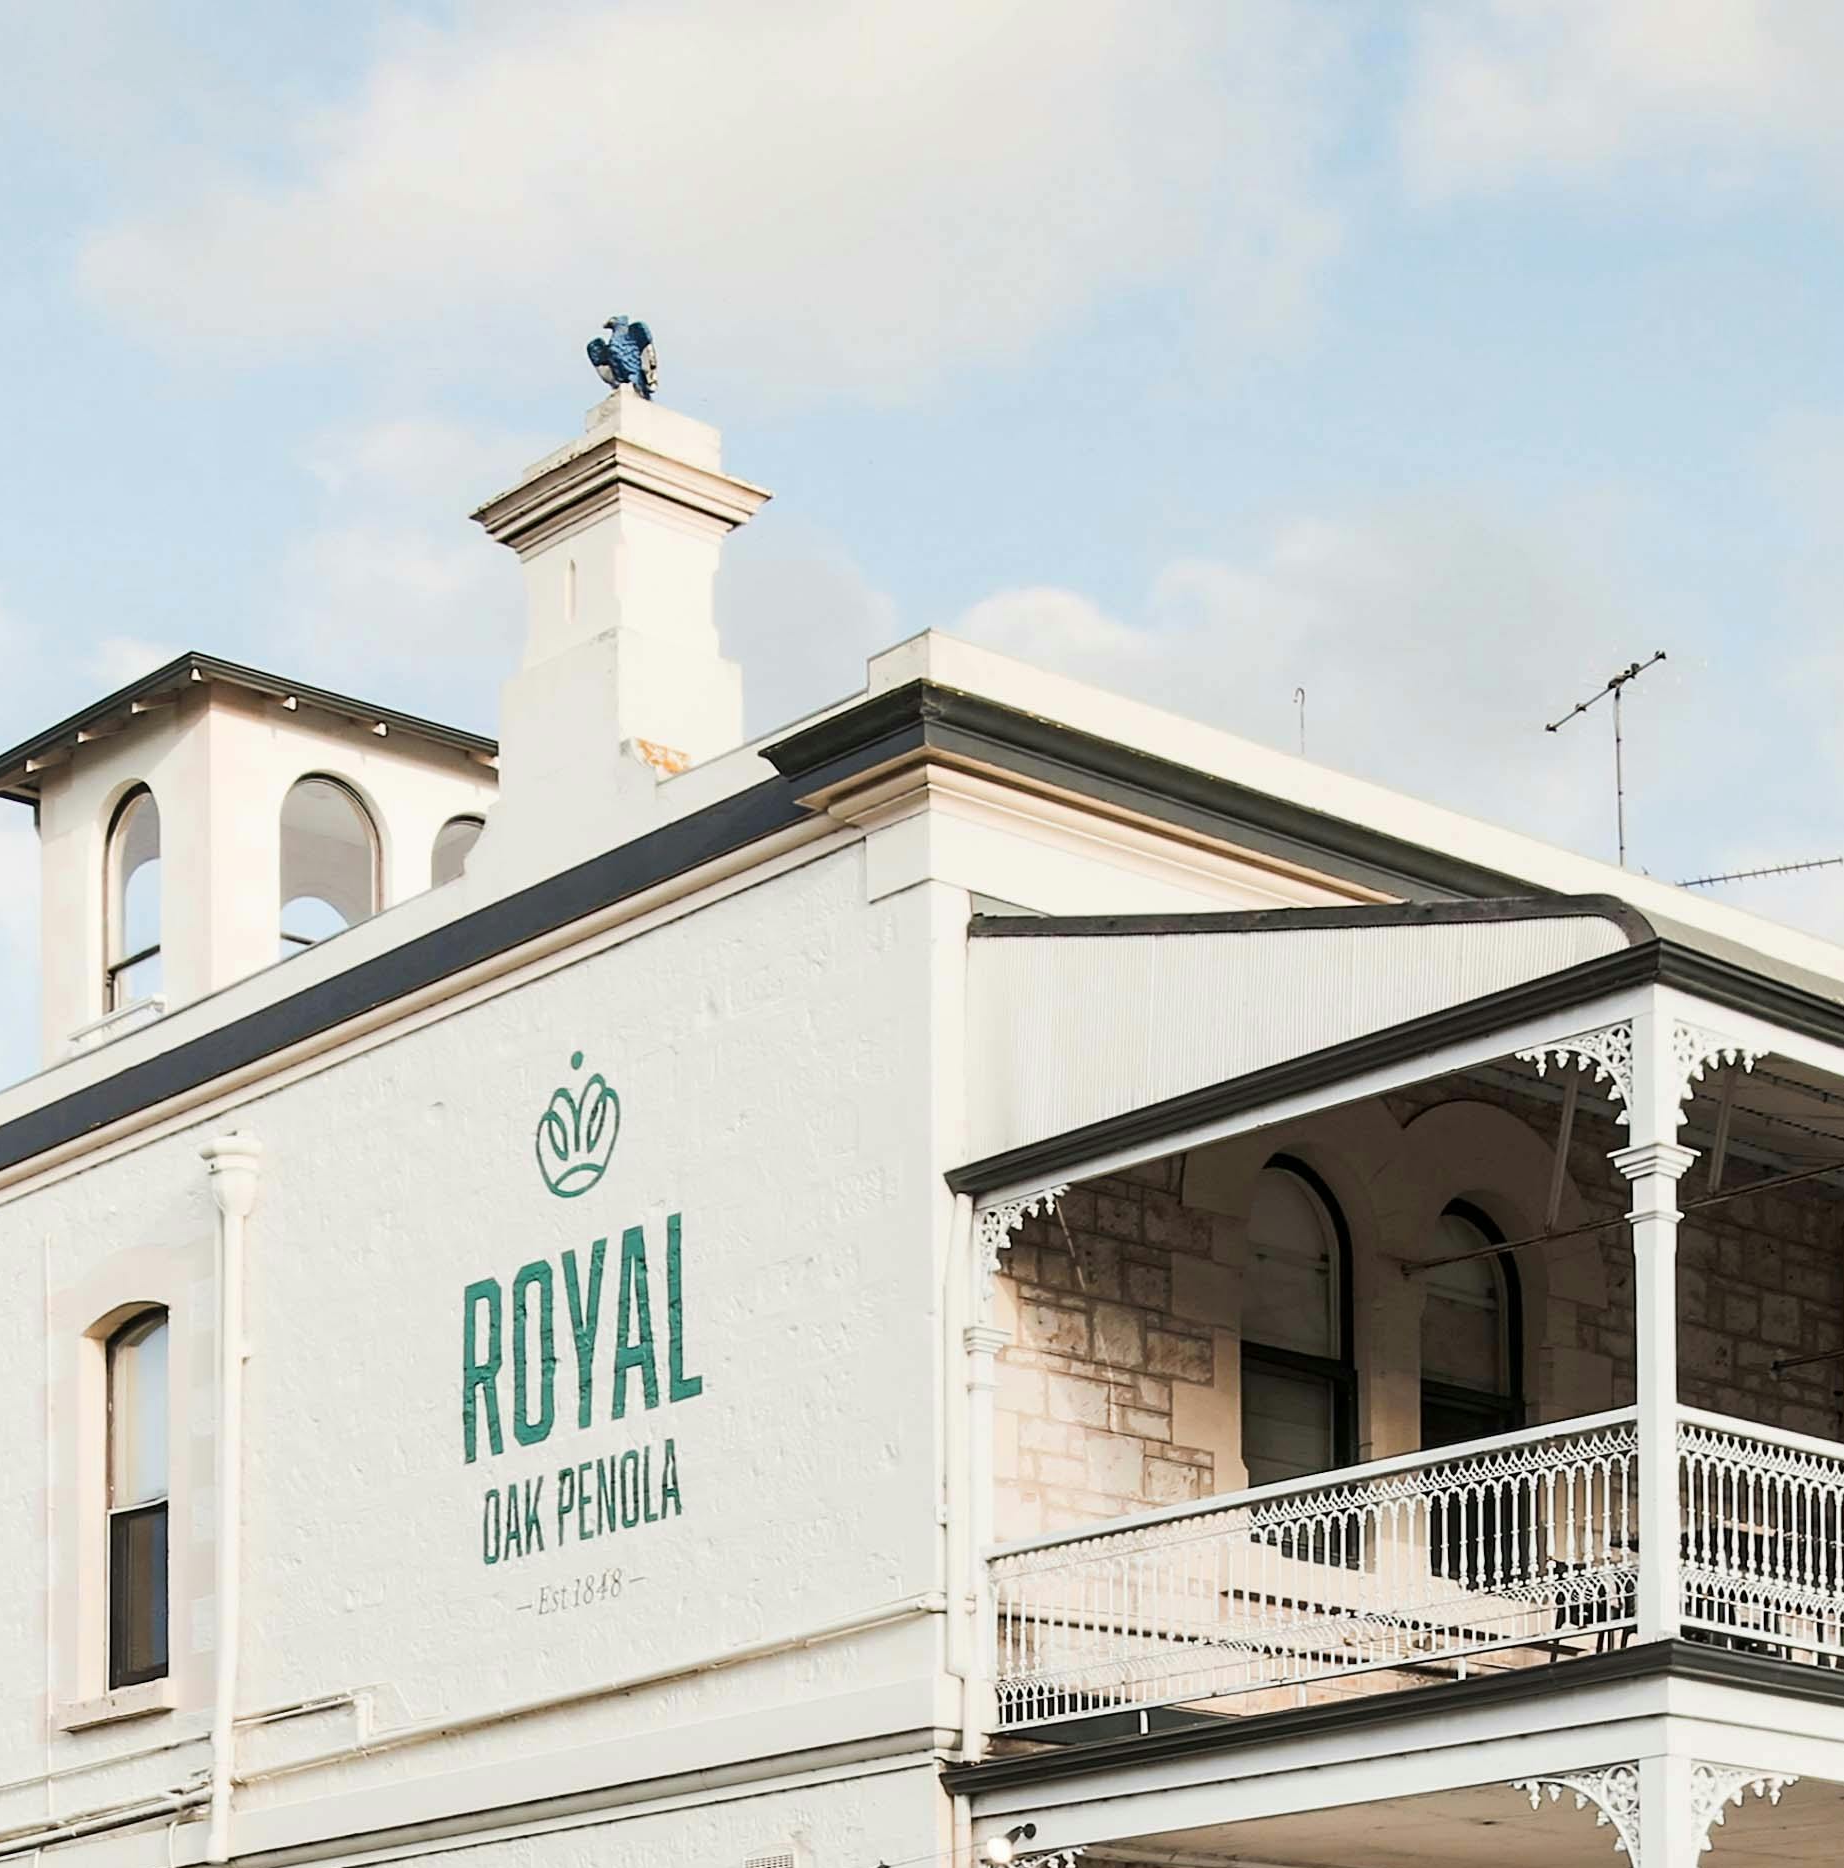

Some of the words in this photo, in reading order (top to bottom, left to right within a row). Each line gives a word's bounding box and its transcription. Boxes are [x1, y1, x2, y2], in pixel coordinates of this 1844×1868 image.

[464, 1212, 703, 1464] ROYAL
[483, 1475, 545, 1565] OAK
[558, 1438, 683, 1546] PENOLA
[539, 1585, 566, 1615] Est
[574, 1568, 622, 1608] 1848
